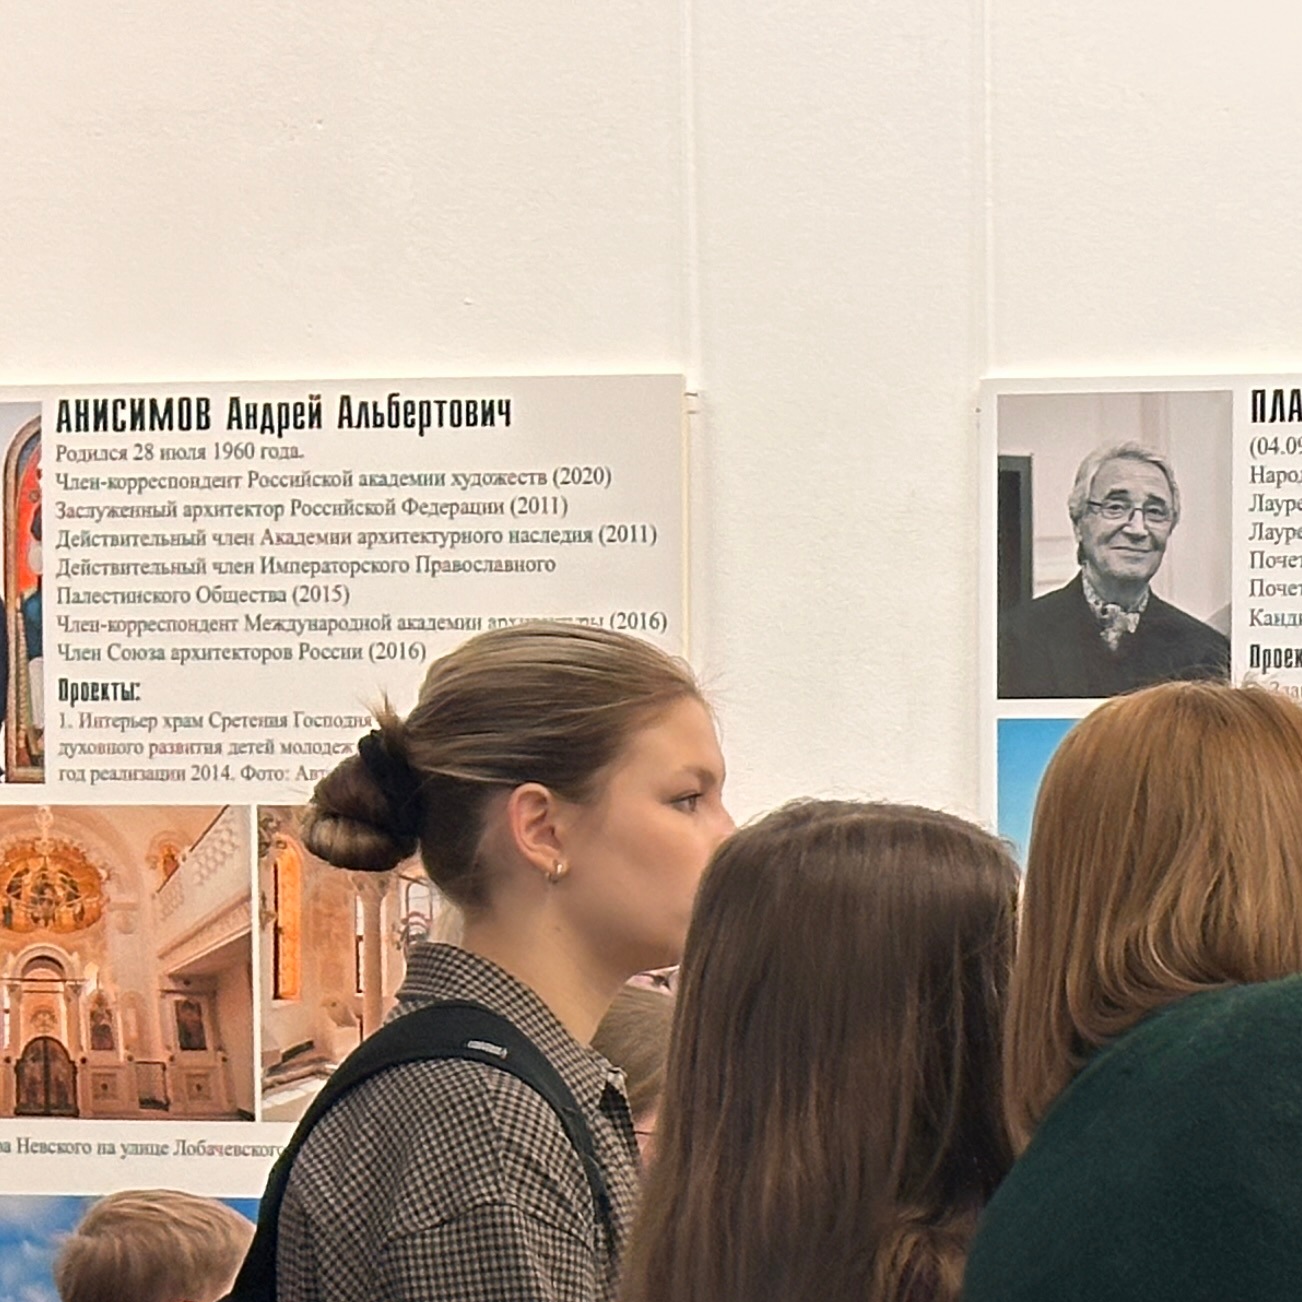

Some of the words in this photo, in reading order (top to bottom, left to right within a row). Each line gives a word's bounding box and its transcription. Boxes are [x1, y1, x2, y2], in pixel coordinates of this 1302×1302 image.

[55, 396, 211, 434] АНИСИМОВ
[226, 392, 323, 440] Андрей
[337, 391, 511, 438] Альбертович
[55, 442, 128, 464] Родился
[132, 441, 155, 462] 28
[159, 446, 207, 462] июля
[214, 440, 256, 462] 1960
[260, 445, 305, 462] года.
[55, 471, 244, 497] Член-корреспондент
[247, 469, 354, 490] Российской
[358, 472, 446, 489] академии
[450, 471, 548, 492] художеств
[552, 465, 612, 491] (2020)
[55, 499, 178, 525] Заслуженный
[182, 502, 285, 524] архитектор
[290, 497, 397, 518] Российской
[401, 496, 505, 521] Федерации
[509, 495, 569, 520] (2011)
[54, 528, 207, 551] Действительный
[211, 532, 255, 548] член
[259, 526, 352, 547] Академии
[356, 529, 504, 551] архитектурного
[508, 529, 594, 546] наследия
[598, 523, 658, 548] (2011)
[55, 556, 208, 580] Действительный
[211, 560, 255, 576] член
[259, 555, 411, 580] Императорского
[415, 553, 557, 579] Православного
[56, 585, 192, 605] Палестинского
[195, 583, 288, 606] Общества
[291, 583, 351, 608] (2015)
[56, 613, 240, 639] Член-корреспондент
[244, 612, 393, 638] Международной
[396, 616, 482, 632] академии
[609, 610, 668, 634] (2016)
[57, 641, 102, 662] Член
[106, 641, 166, 662] Союза
[170, 646, 294, 667] архитекторов
[298, 641, 364, 662] России
[368, 641, 427, 665] (2016)
[58, 677, 141, 709] Проекты:
[59, 711, 73, 729] 1.
[78, 711, 159, 734] Интерьер
[162, 715, 204, 734] храм
[207, 710, 288, 734] Сретения
[292, 710, 373, 730] Господня
[57, 741, 145, 760] духовного
[148, 741, 223, 761] развития
[226, 737, 275, 757] детей
[279, 741, 356, 758] молодеж
[58, 768, 87, 784] год
[89, 767, 186, 787] реализации
[190, 763, 236, 783] 2014.
[239, 763, 290, 783] Фото:
[15, 1136, 93, 1156] Невского
[96, 1142, 117, 1157] на
[119, 1142, 170, 1160] улице
